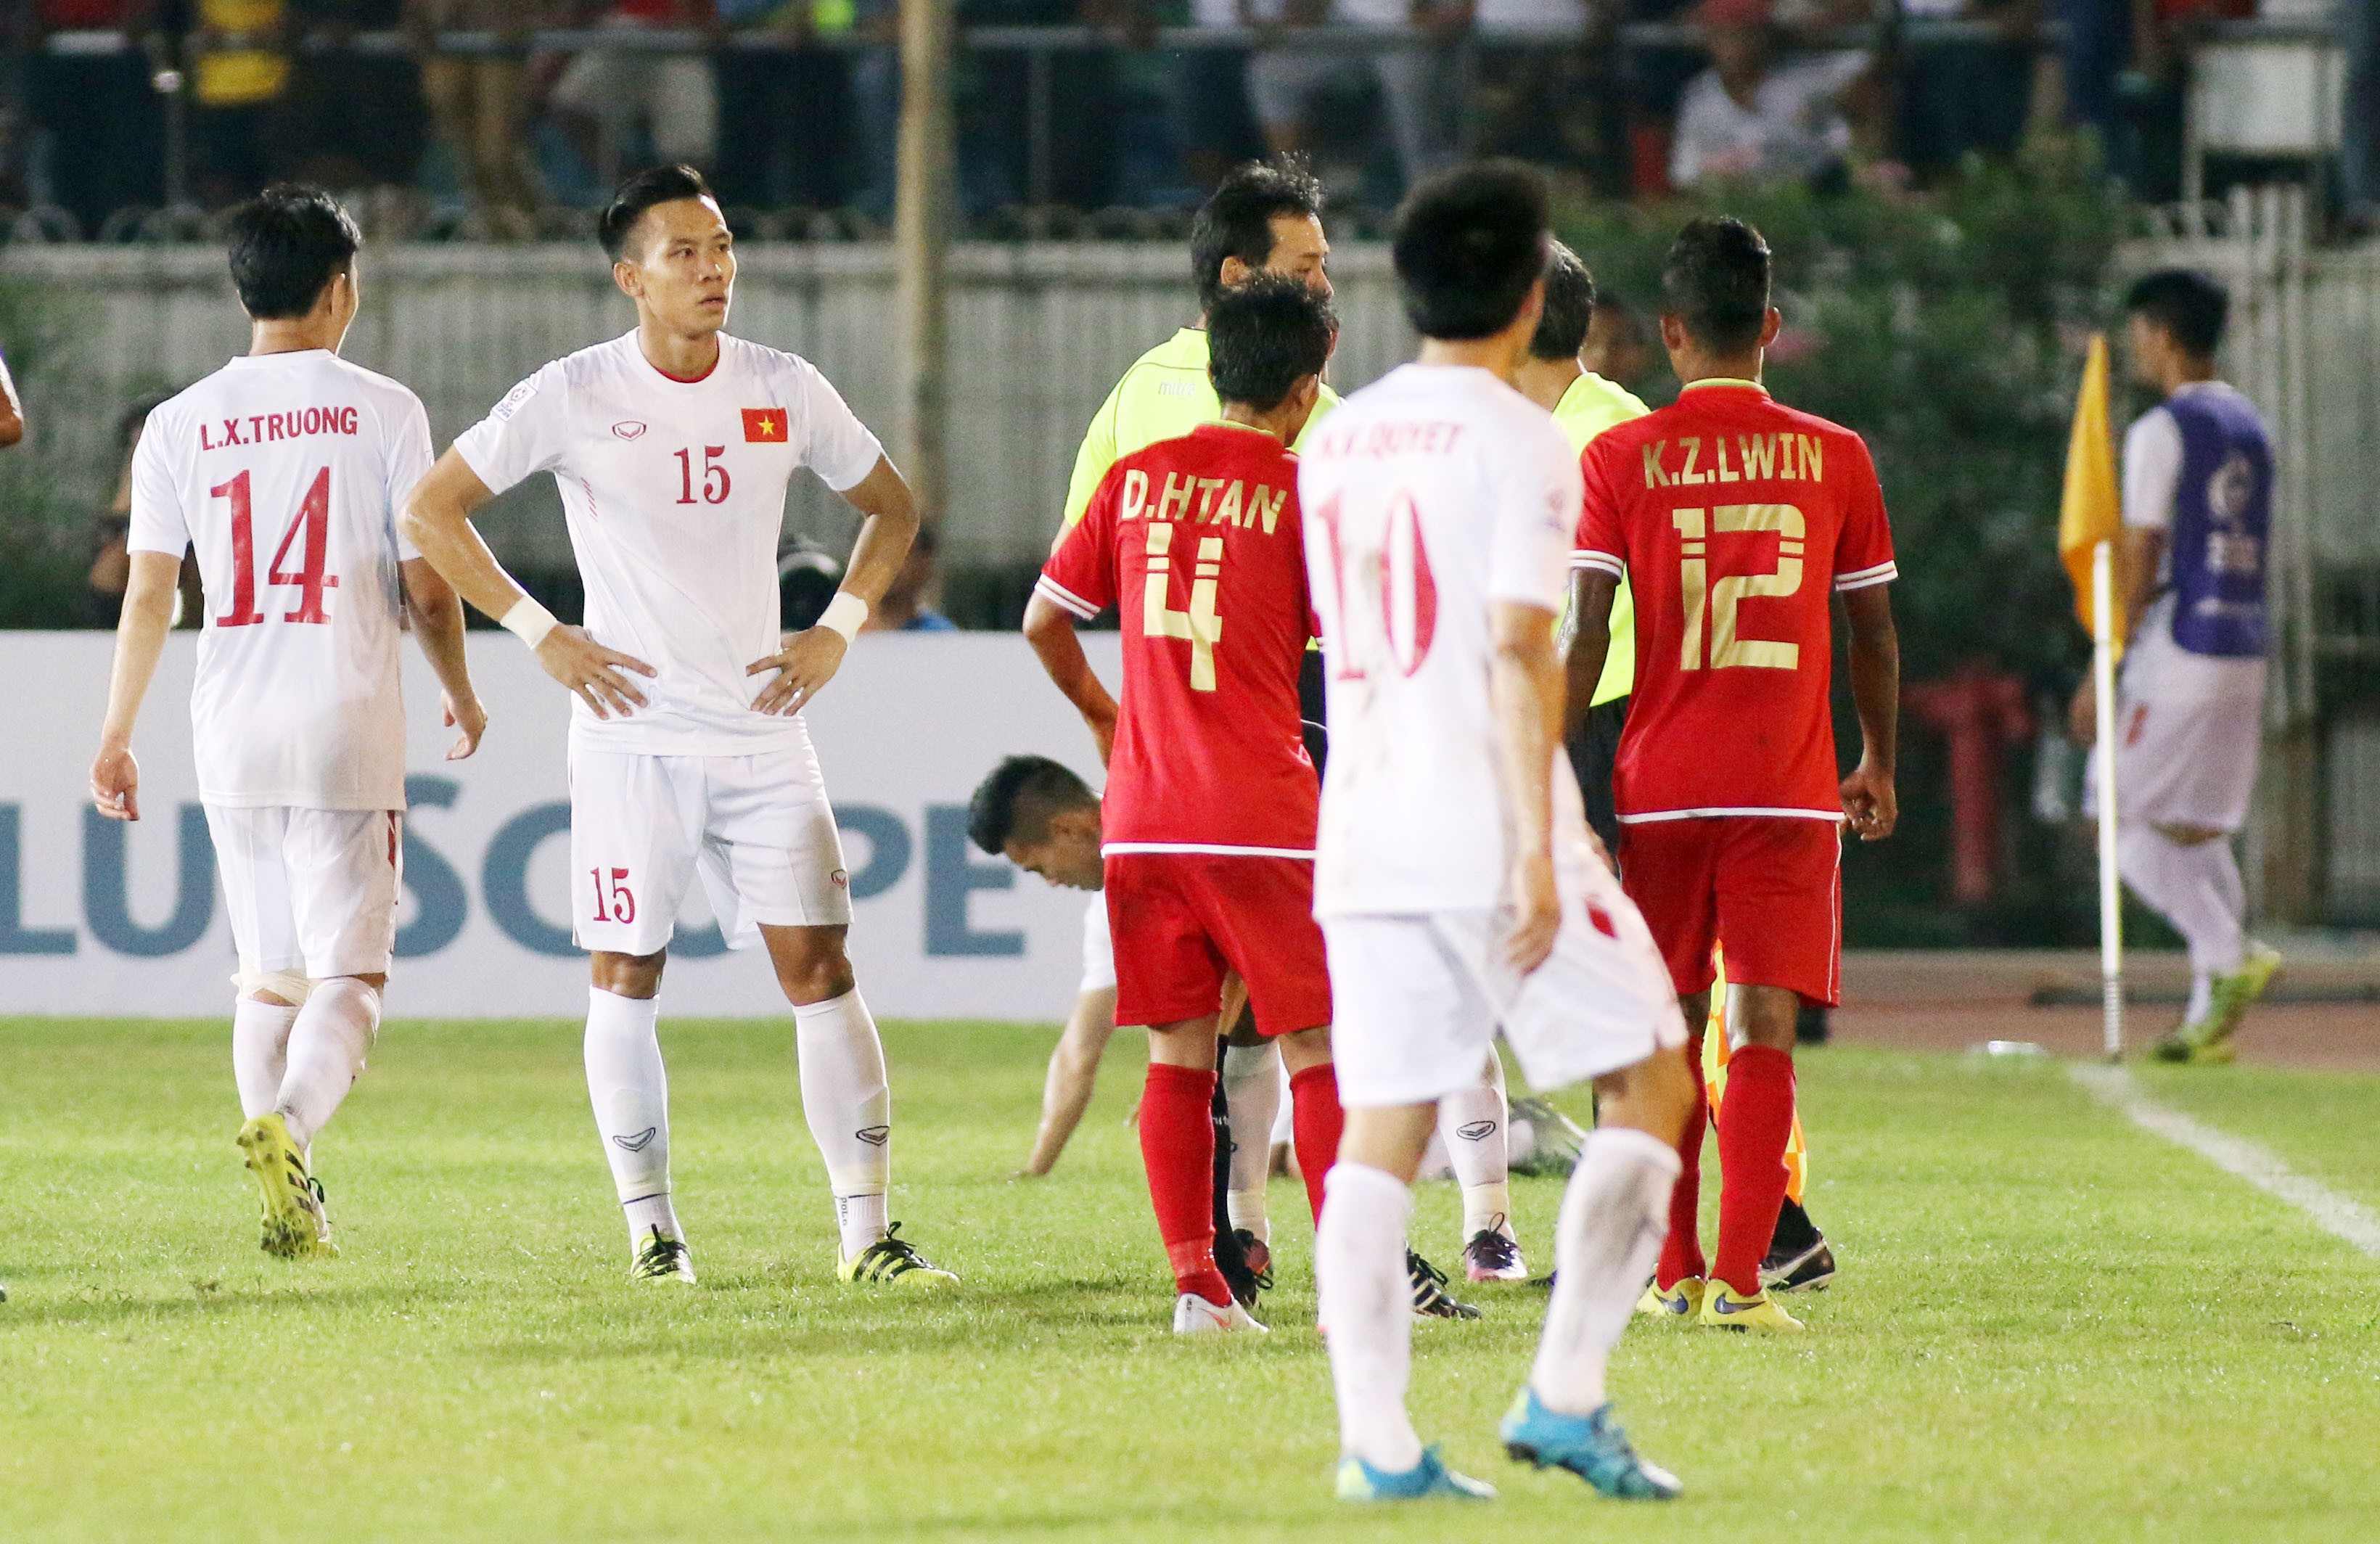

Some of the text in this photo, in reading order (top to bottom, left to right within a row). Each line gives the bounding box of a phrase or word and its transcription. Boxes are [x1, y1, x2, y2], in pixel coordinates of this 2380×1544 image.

[201, 406, 358, 451] L.X.TRUONG
[1643, 432, 1823, 489] K.Z.LWIN
[673, 445, 731, 504] 15
[1122, 469, 1287, 535] D.HTAN
[210, 466, 339, 627] 14
[1144, 522, 1224, 691] 4
[1315, 486, 1438, 681] 10
[1672, 504, 1806, 670] 12
[591, 867, 636, 924] 15
